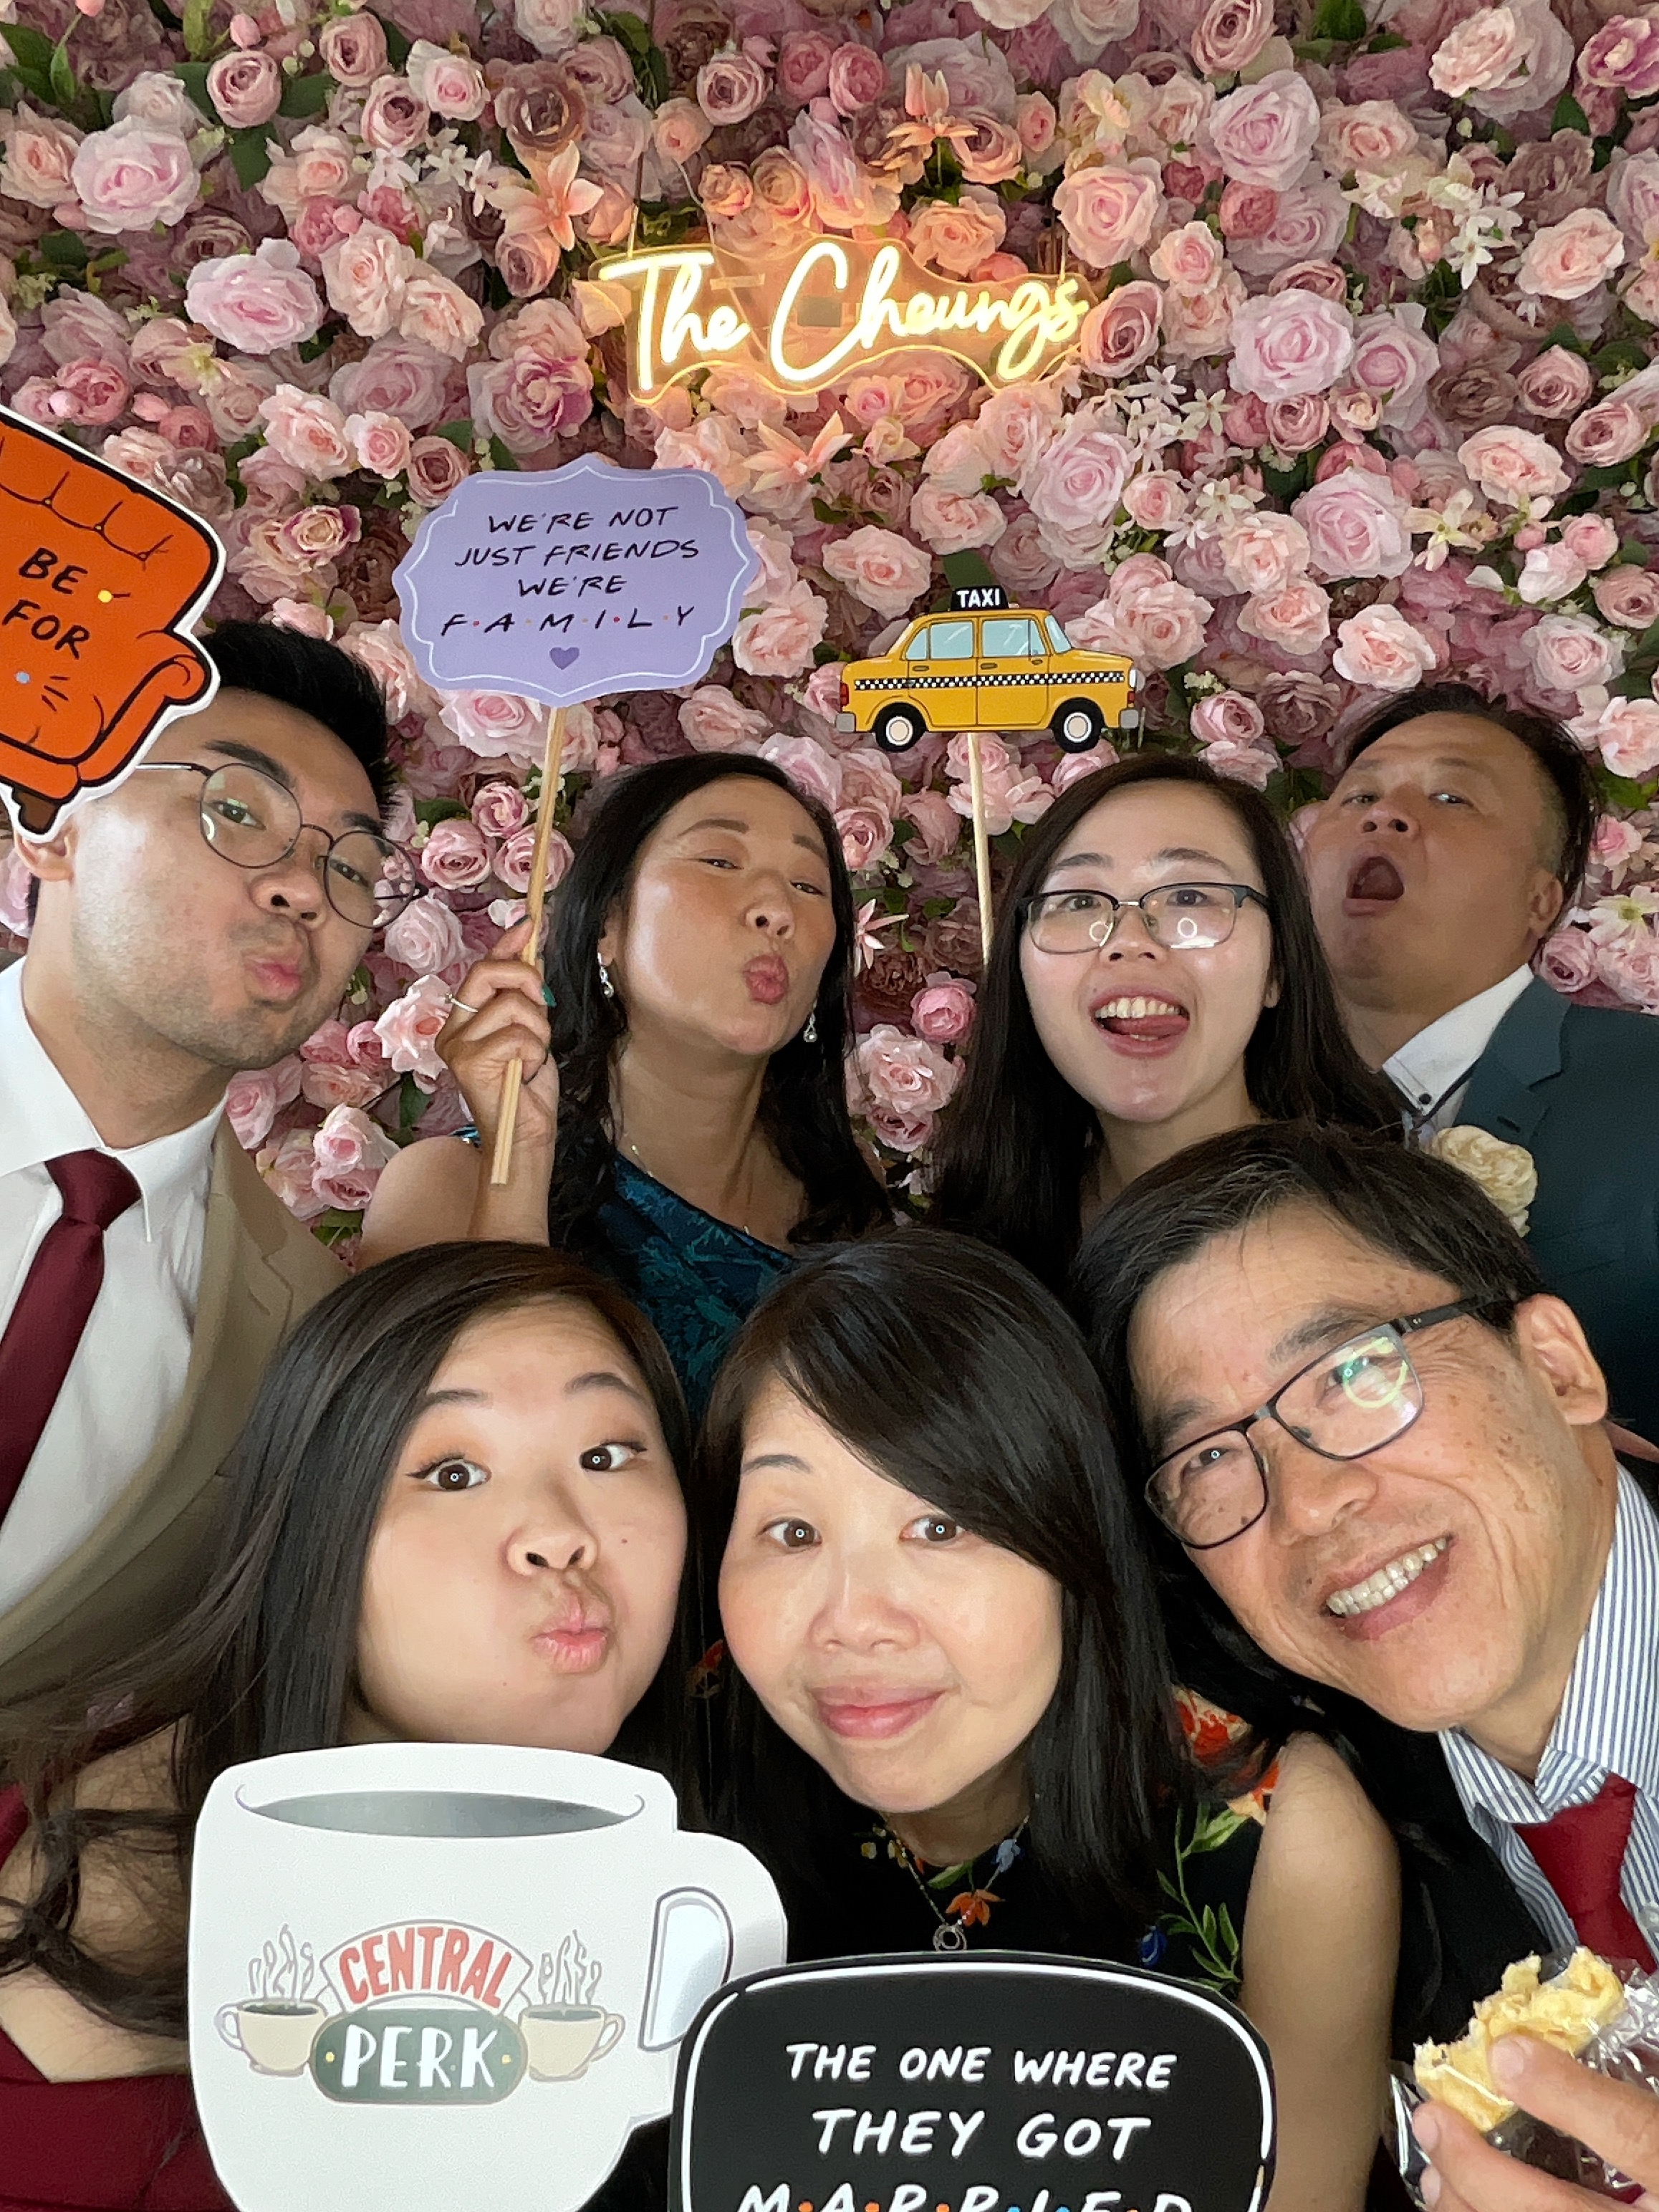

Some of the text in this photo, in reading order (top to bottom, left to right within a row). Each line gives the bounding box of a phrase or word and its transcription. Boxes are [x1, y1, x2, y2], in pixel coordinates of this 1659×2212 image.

[599, 241, 1088, 390] The Cheungs
[489, 506, 679, 534] WE'RE NOT
[19, 547, 88, 595] BE
[455, 539, 699, 567] JUST FRIENDS
[518, 574, 627, 597] WE'RE
[956, 588, 1000, 608] TAXI
[1, 599, 90, 660] FOR
[340, 1927, 511, 2006] CENTRAL
[786, 2042, 1177, 2089] THE ONE WHERE
[812, 2108, 1152, 2160] THEY GOT
